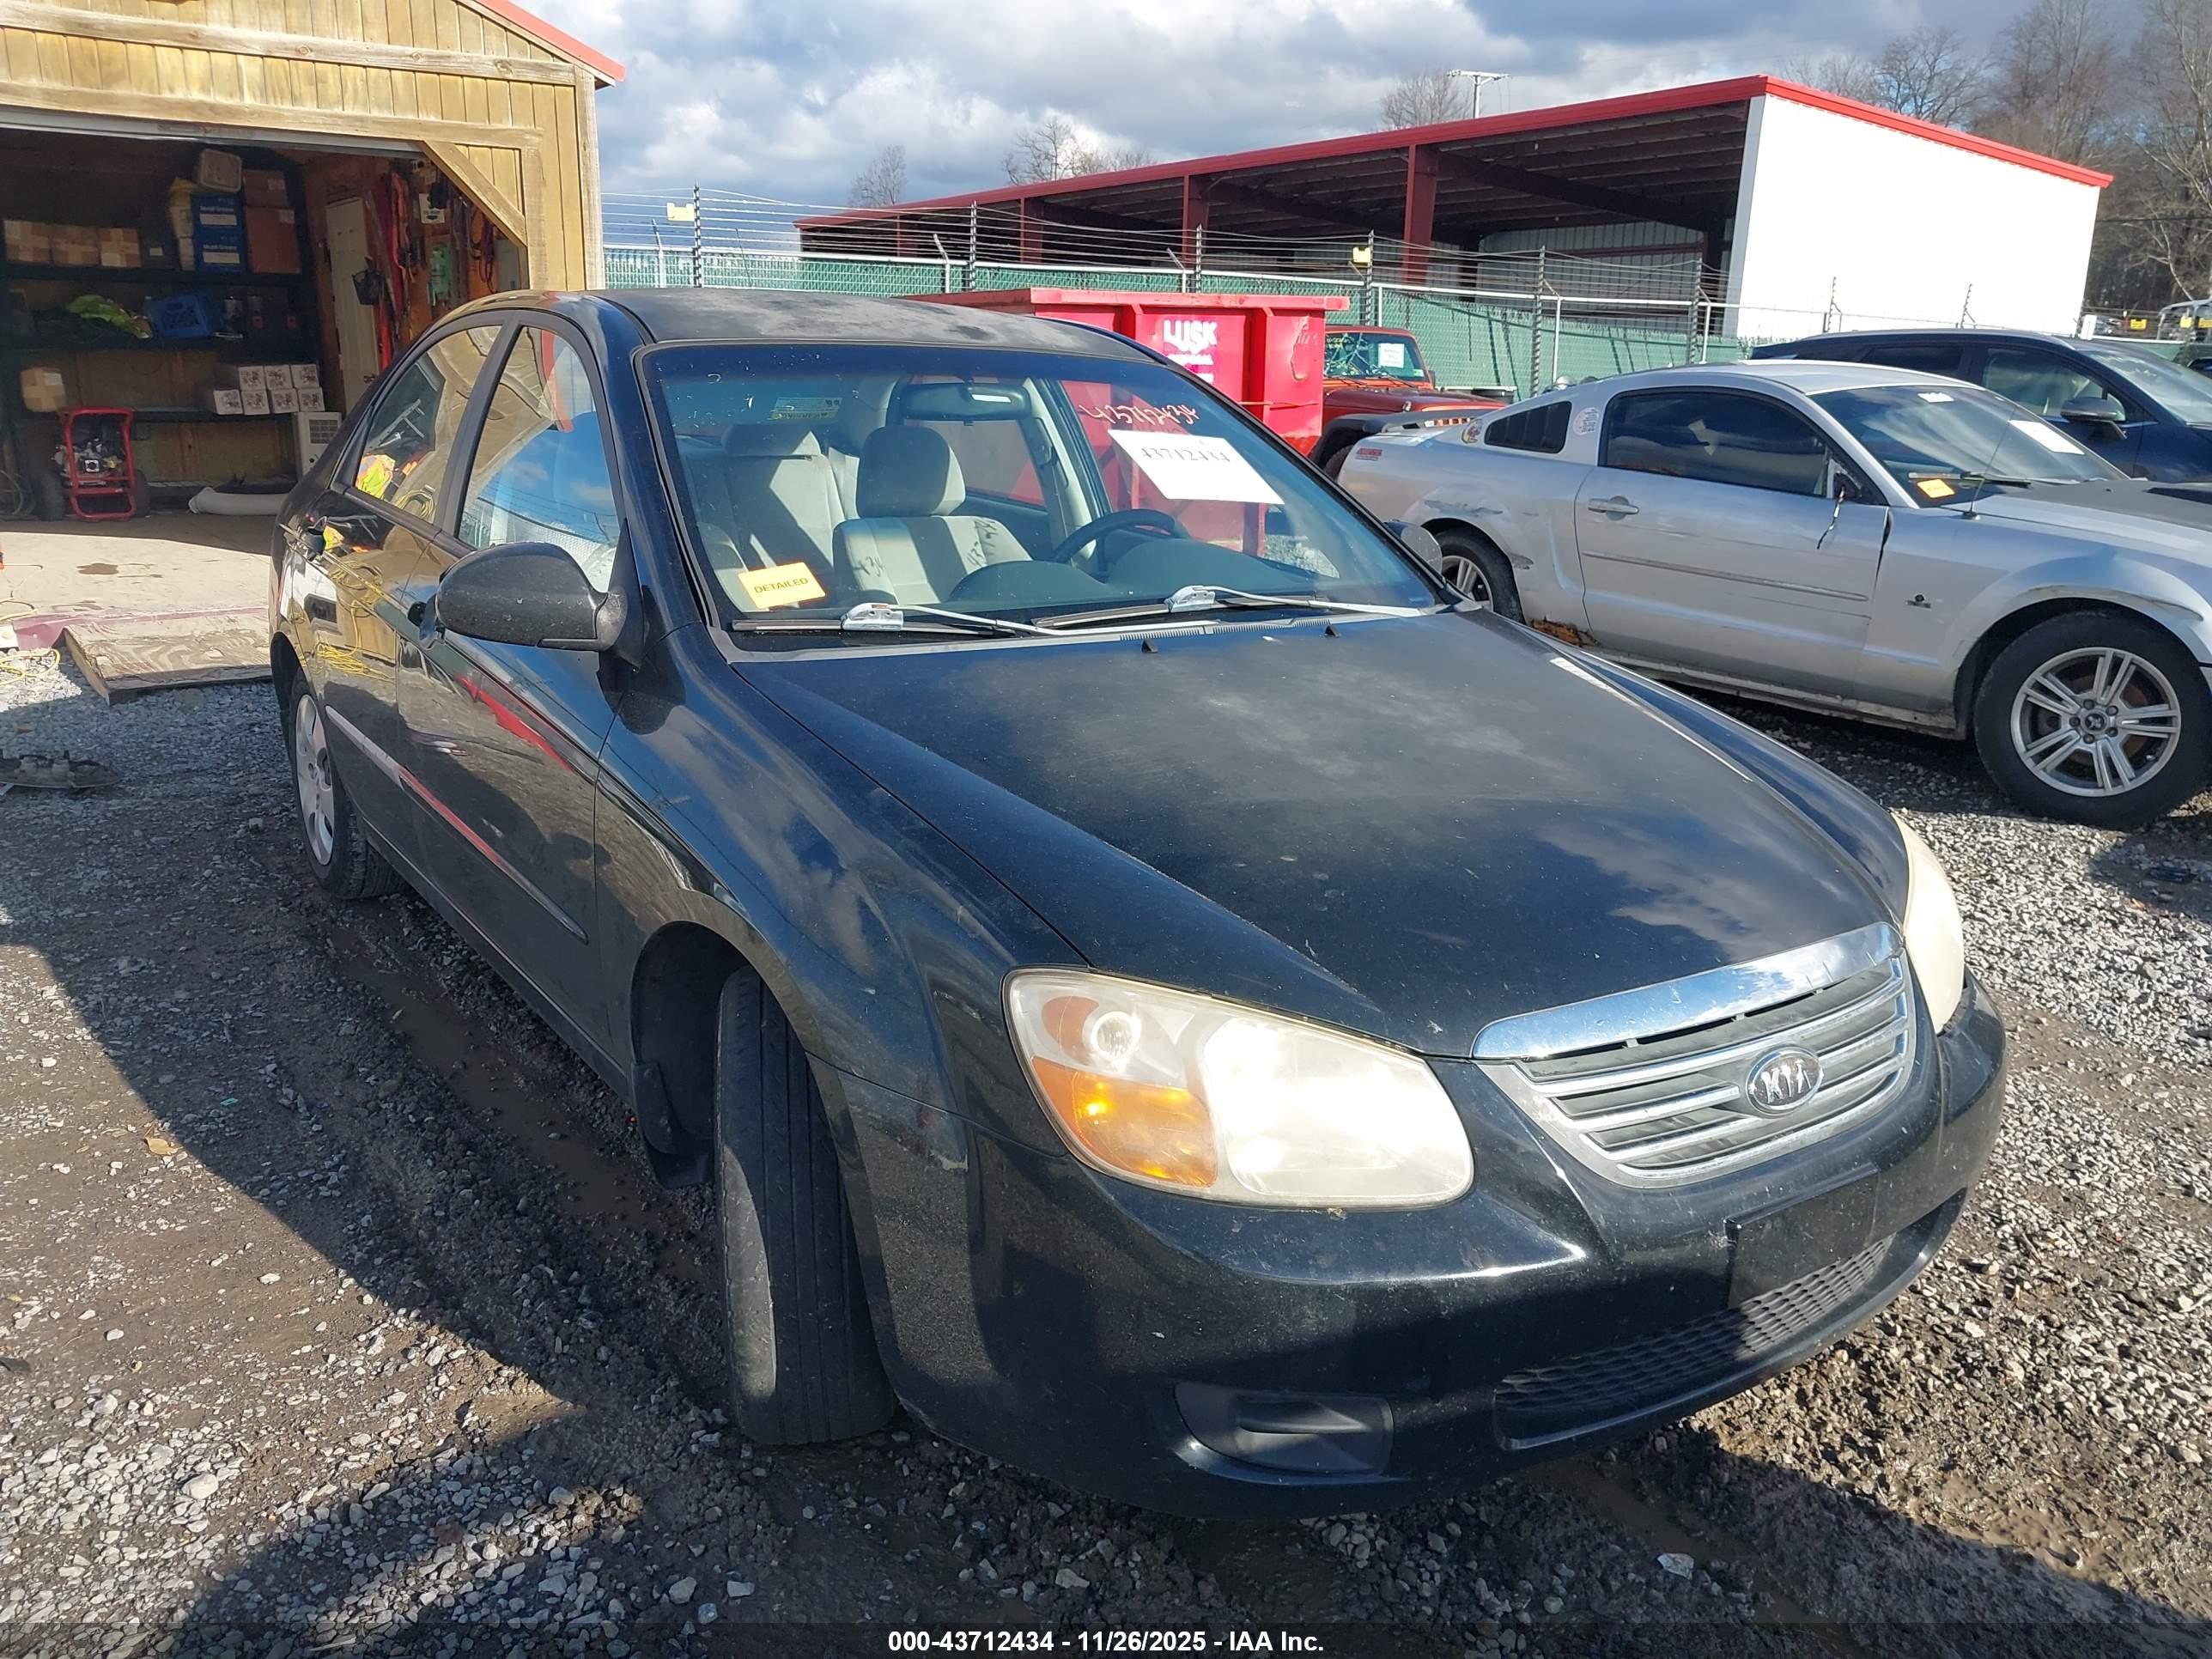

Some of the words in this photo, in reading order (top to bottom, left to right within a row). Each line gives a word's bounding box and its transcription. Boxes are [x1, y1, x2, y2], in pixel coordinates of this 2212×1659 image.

[1164, 319, 1218, 353] LUSK
[1079, 404, 1200, 425] 43712434
[753, 577, 809, 593] DETAILED
